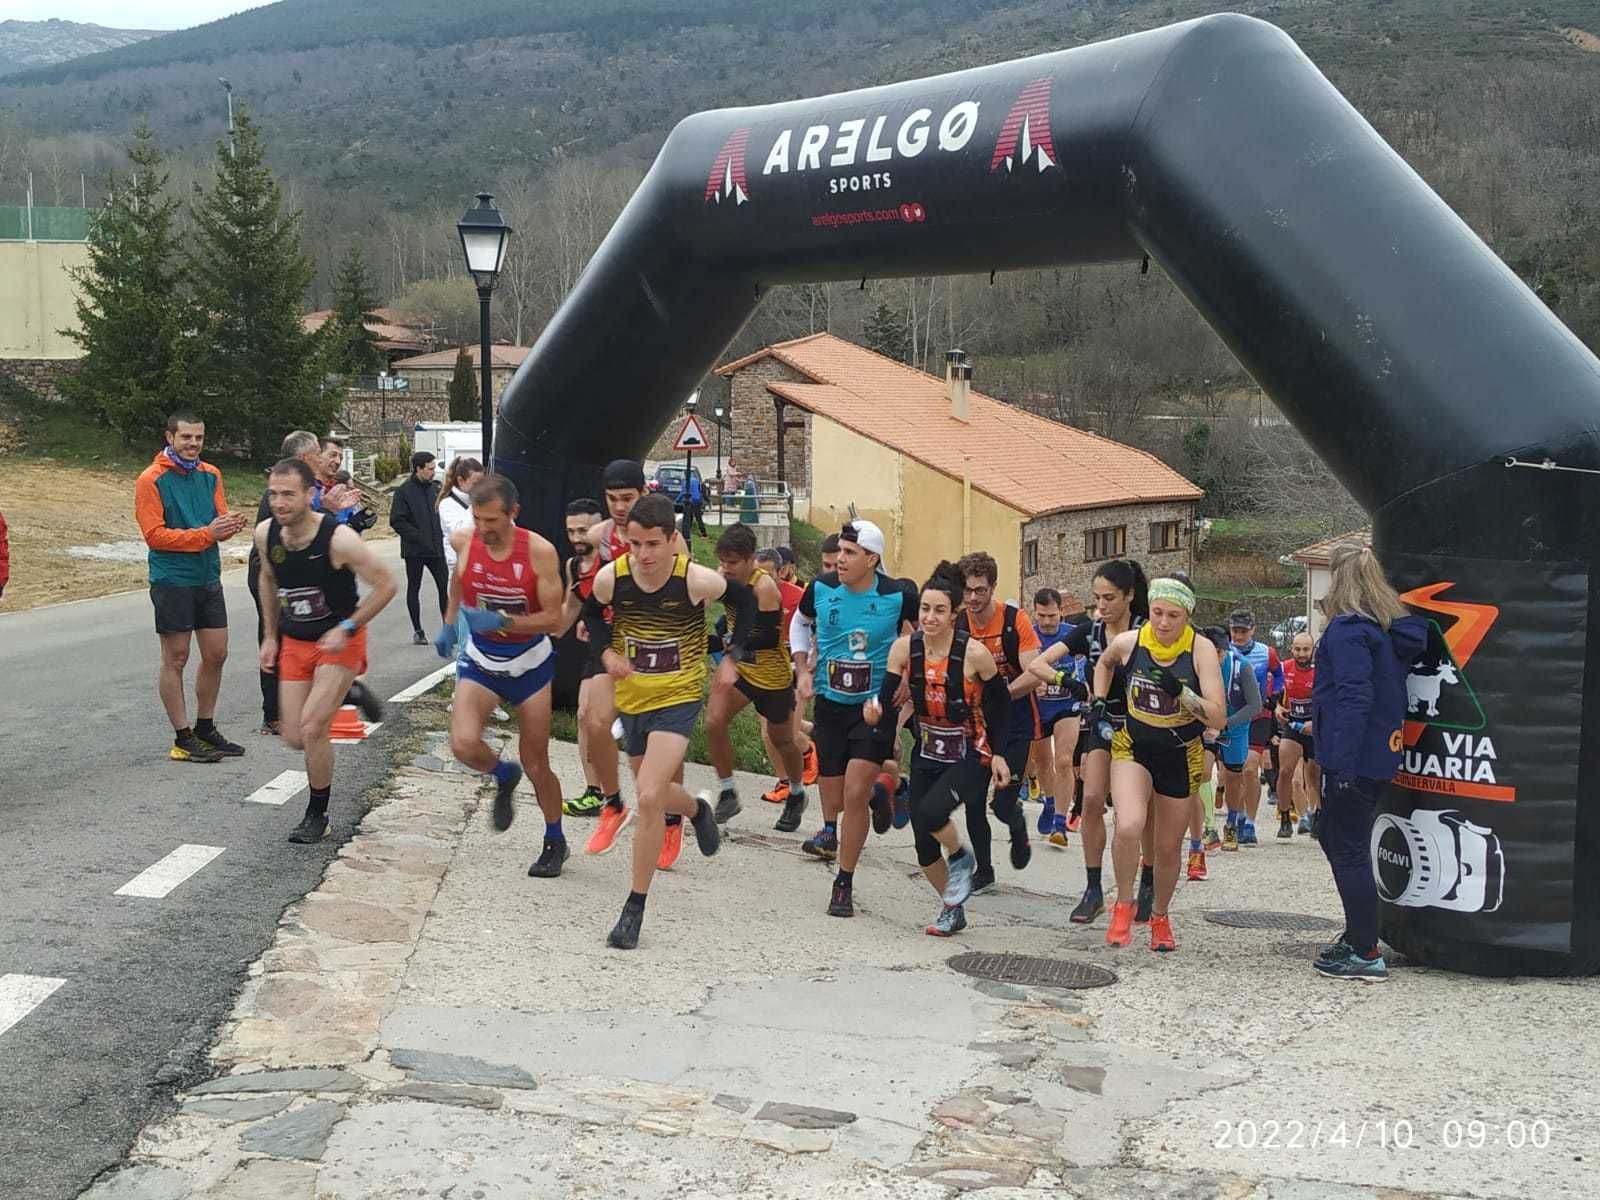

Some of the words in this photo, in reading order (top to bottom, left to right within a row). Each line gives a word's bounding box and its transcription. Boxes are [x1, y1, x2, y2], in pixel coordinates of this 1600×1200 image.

[830, 172, 892, 194] SPORTS
[811, 208, 898, 228] arelgosports.com
[647, 653, 657, 668] 7
[843, 672, 853, 687] 9
[935, 739, 946, 754] 2
[1442, 731, 1498, 760] VIA
[1398, 749, 1497, 784] UARIA
[1378, 846, 1410, 868] FOCAVI
